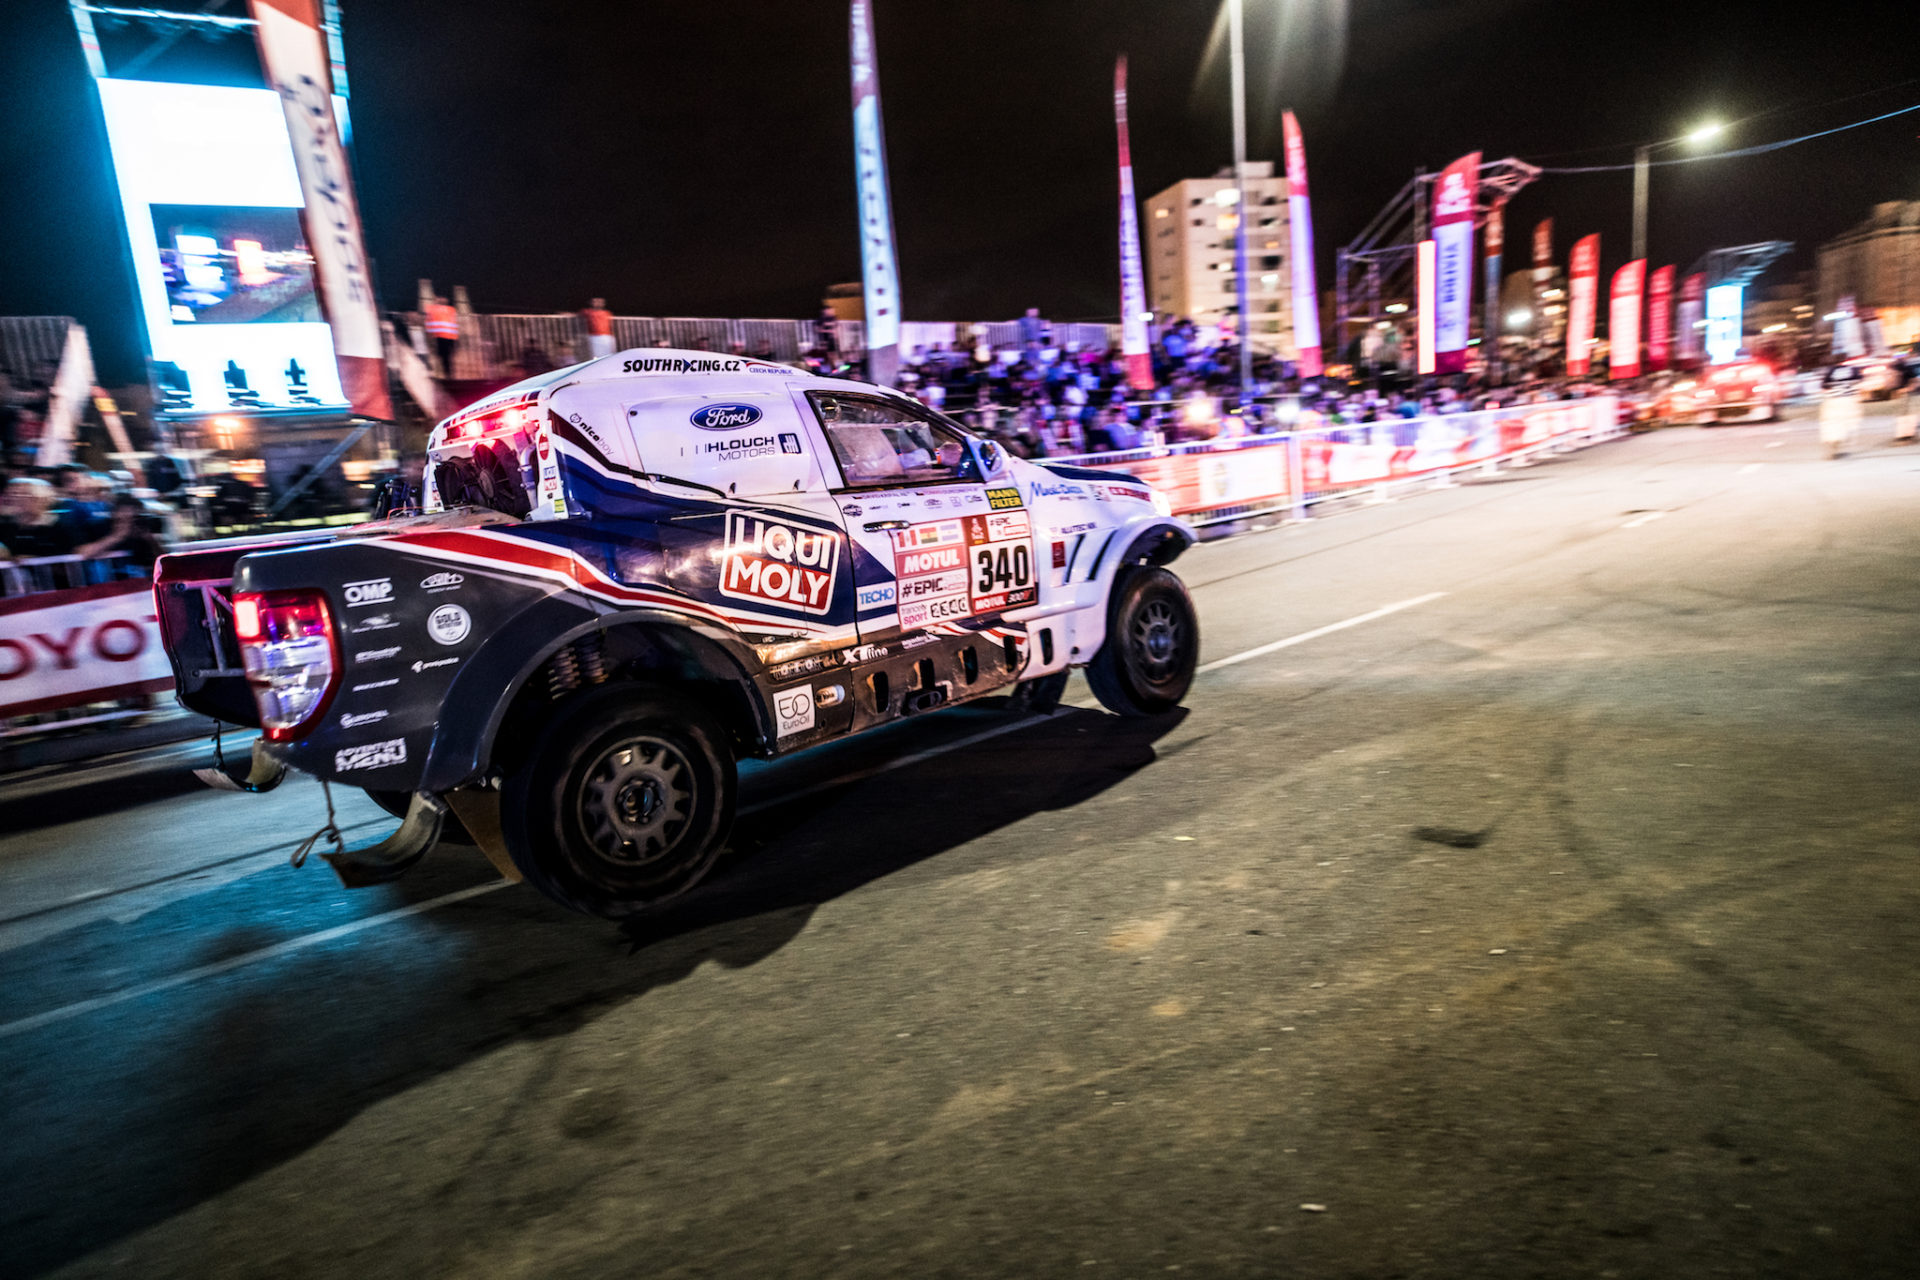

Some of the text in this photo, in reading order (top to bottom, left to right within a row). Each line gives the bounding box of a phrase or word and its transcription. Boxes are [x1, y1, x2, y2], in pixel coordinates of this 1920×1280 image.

[705, 406, 750, 427] Ford
[719, 447, 775, 461] MOTORS
[986, 489, 1018, 499] MANN
[990, 498, 1022, 509] FILTER
[735, 517, 831, 569] LIQUI
[904, 550, 960, 574] MOTUL
[978, 545, 1028, 593] 340
[729, 557, 829, 605] MOLY
[345, 582, 393, 602] OMP
[859, 587, 894, 605] TECHO
[975, 596, 1005, 612] MOTUL
[903, 610, 928, 626] sport
[0, 615, 159, 681] OYO
